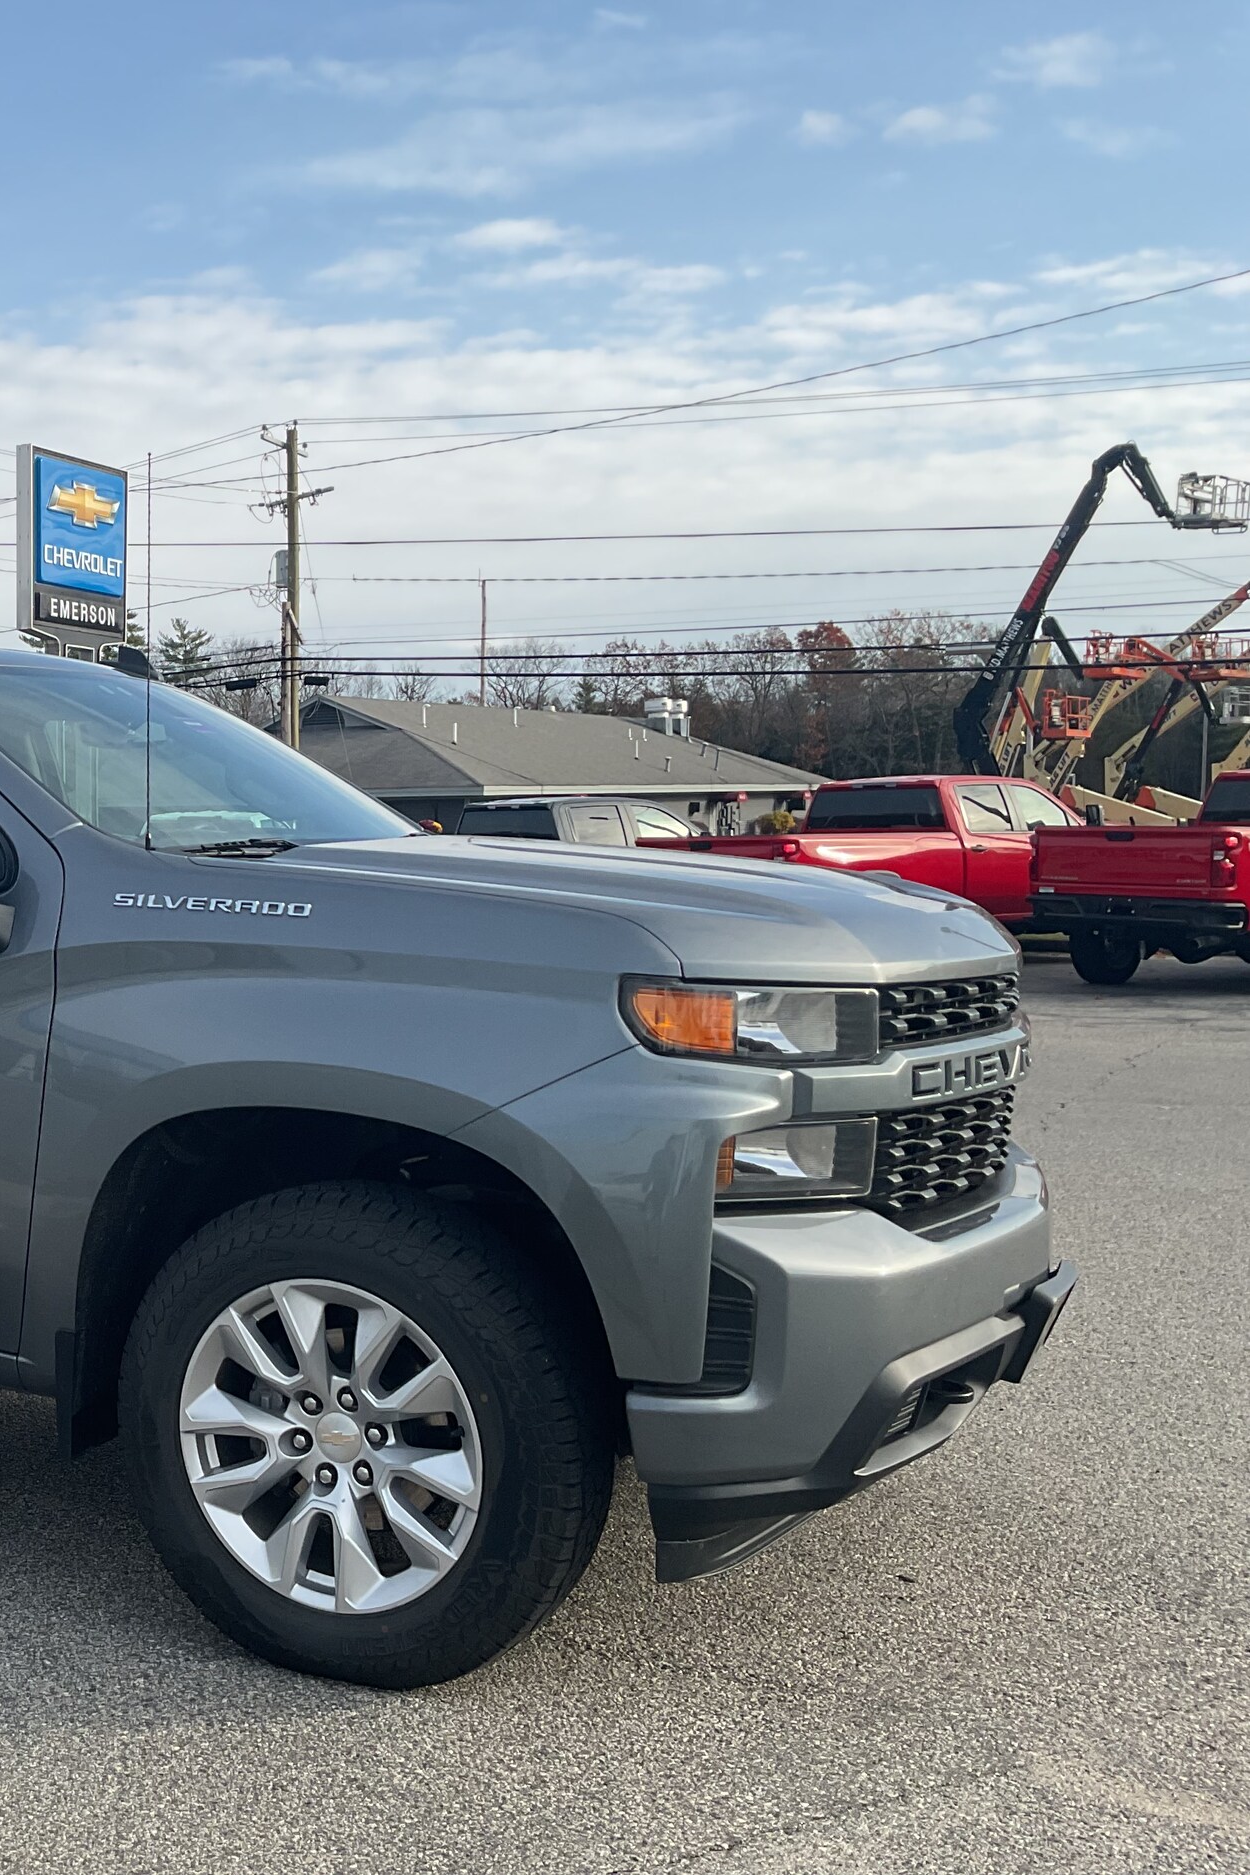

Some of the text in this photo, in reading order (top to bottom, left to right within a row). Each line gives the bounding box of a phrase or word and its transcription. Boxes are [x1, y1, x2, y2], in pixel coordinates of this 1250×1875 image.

[44, 544, 123, 577] CHEVROLET
[50, 598, 116, 627] EMERSON
[1168, 601, 1232, 655] ATTHEWS
[113, 893, 313, 917] SILVERADO
